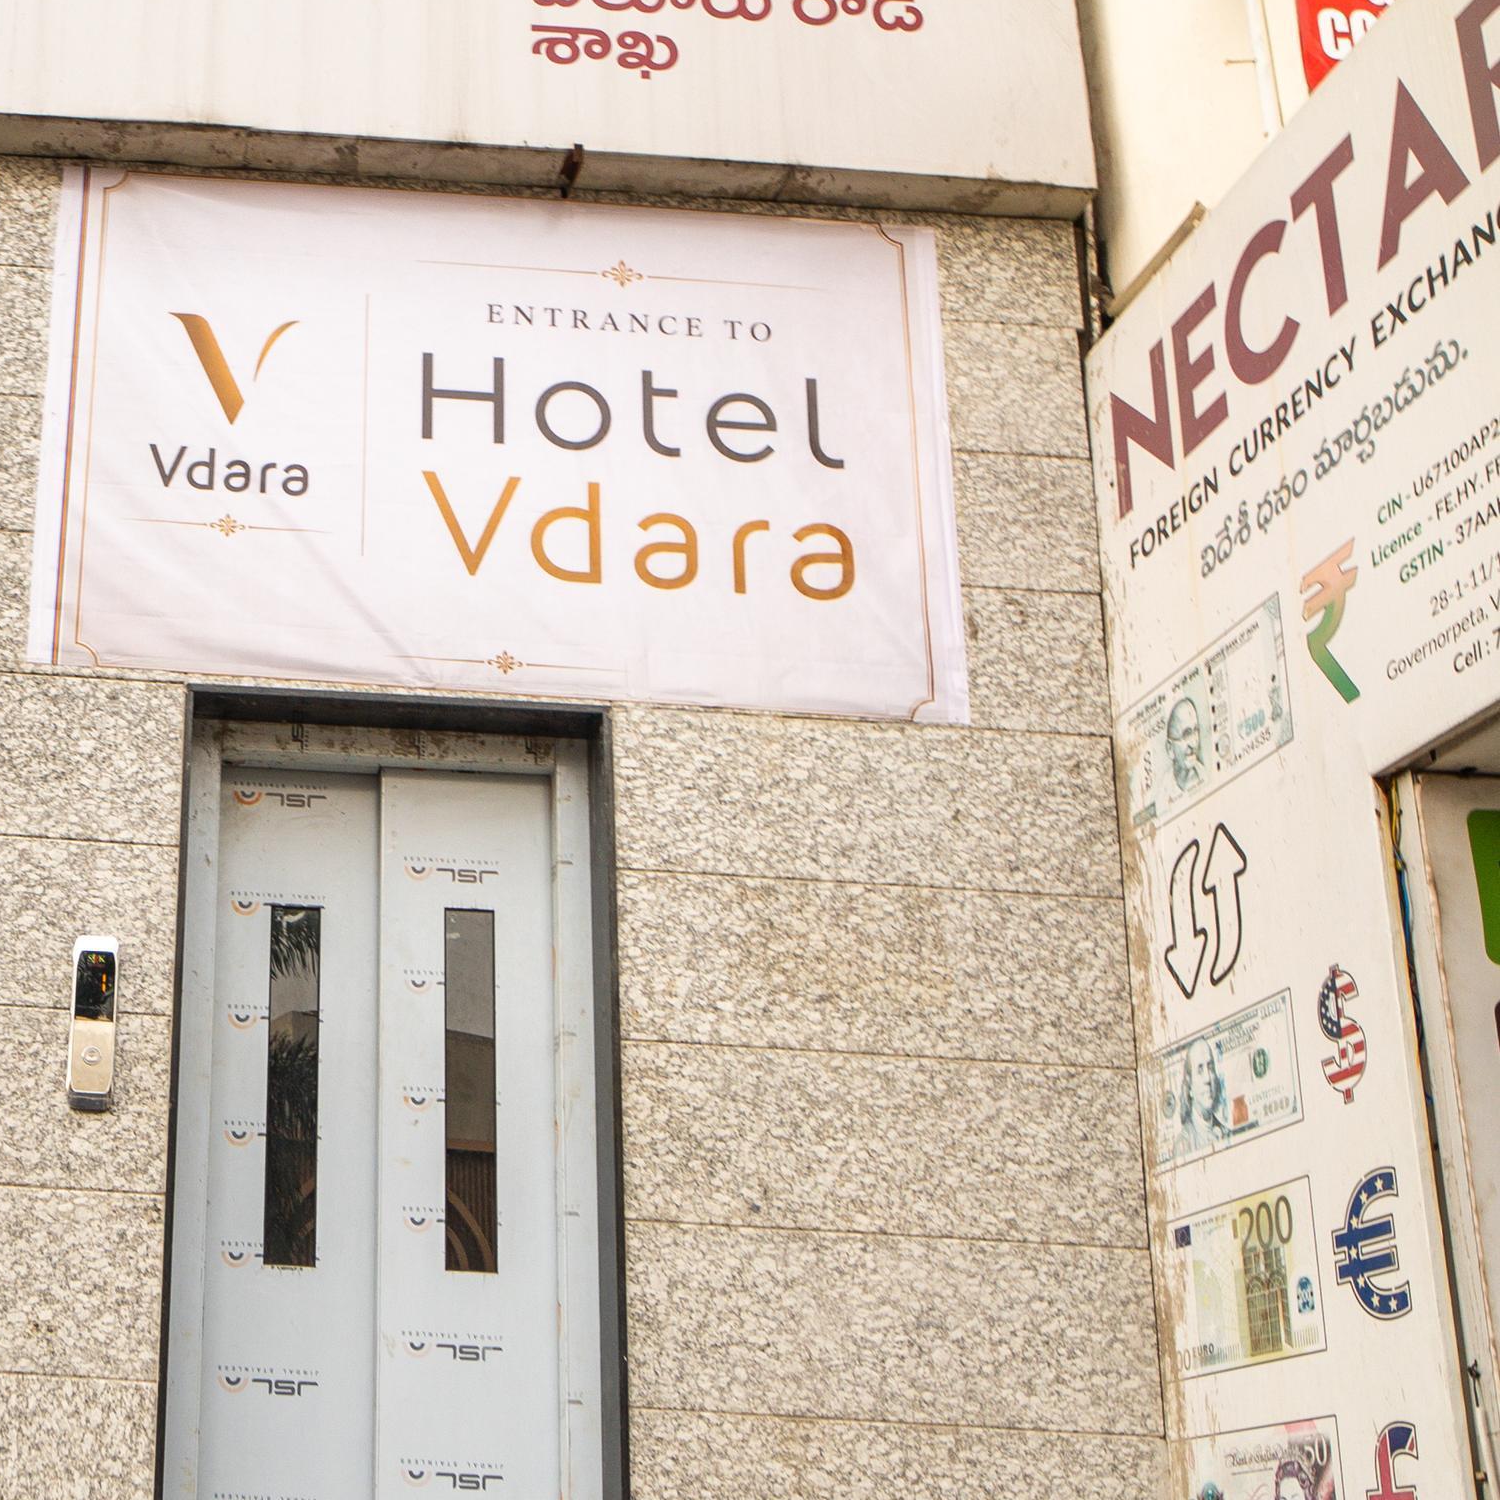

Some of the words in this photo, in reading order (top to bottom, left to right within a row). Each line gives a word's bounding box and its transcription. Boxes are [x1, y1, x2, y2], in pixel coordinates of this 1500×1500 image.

[530, 24, 679, 80] శాఖ
[486, 302, 704, 341] ENTRANCE
[723, 319, 774, 344] TO
[1129, 473, 1221, 570] FOREIGN
[1228, 336, 1360, 478] CURRENCY
[1371, 206, 1500, 350] EXCHAN
[421, 352, 846, 470] Hotel
[149, 443, 310, 497] Vdara
[1377, 493, 1403, 525] CIN
[421, 470, 856, 602] Vdara
[1371, 521, 1422, 568] Licence
[1399, 539, 1445, 584] GSTIN
[1387, 603, 1489, 681] Governorpeta,
[1453, 641, 1483, 675] Cell
[266, 793, 327, 808] JSL
[437, 868, 500, 883] JSL
[436, 1343, 504, 1362] JSL
[252, 1377, 319, 1397] JSL
[435, 1472, 504, 1491] JSL
